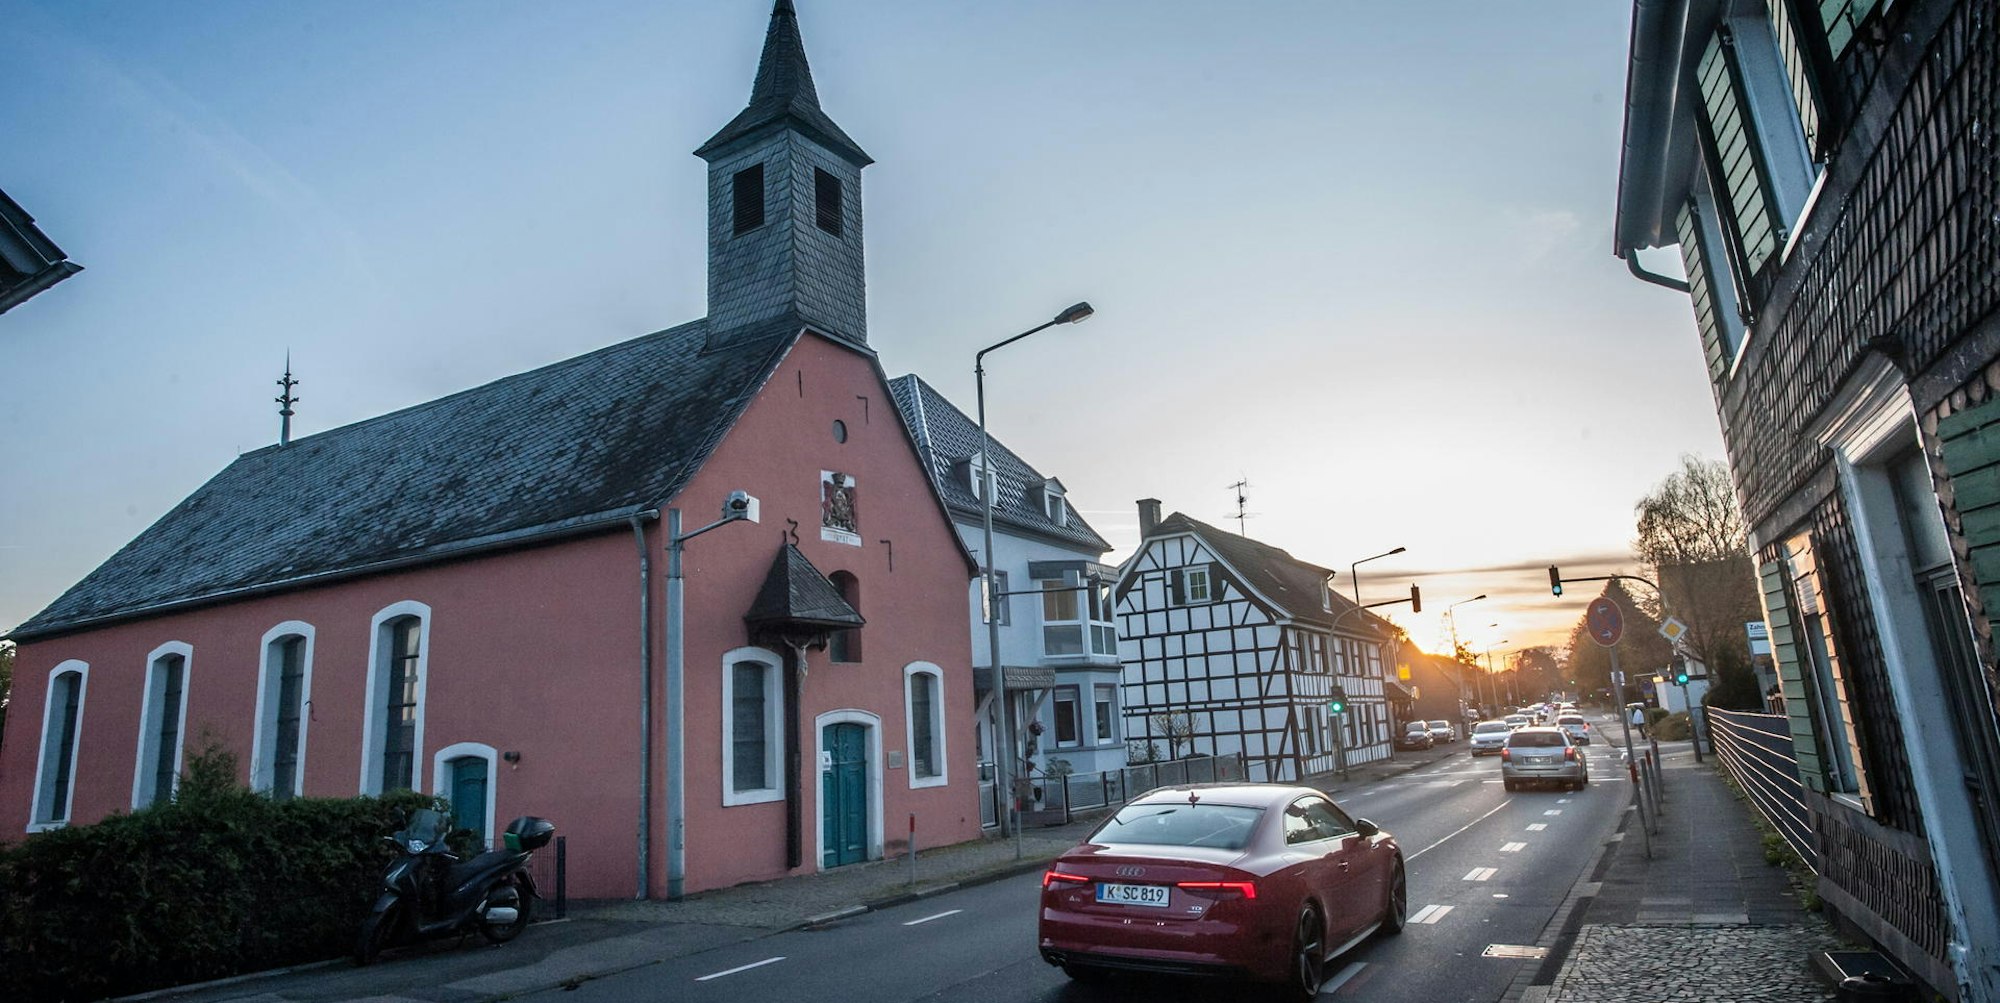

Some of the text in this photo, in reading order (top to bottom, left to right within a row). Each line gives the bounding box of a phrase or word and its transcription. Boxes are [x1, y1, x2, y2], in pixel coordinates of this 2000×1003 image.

[1107, 886, 1164, 902] K SC 819
